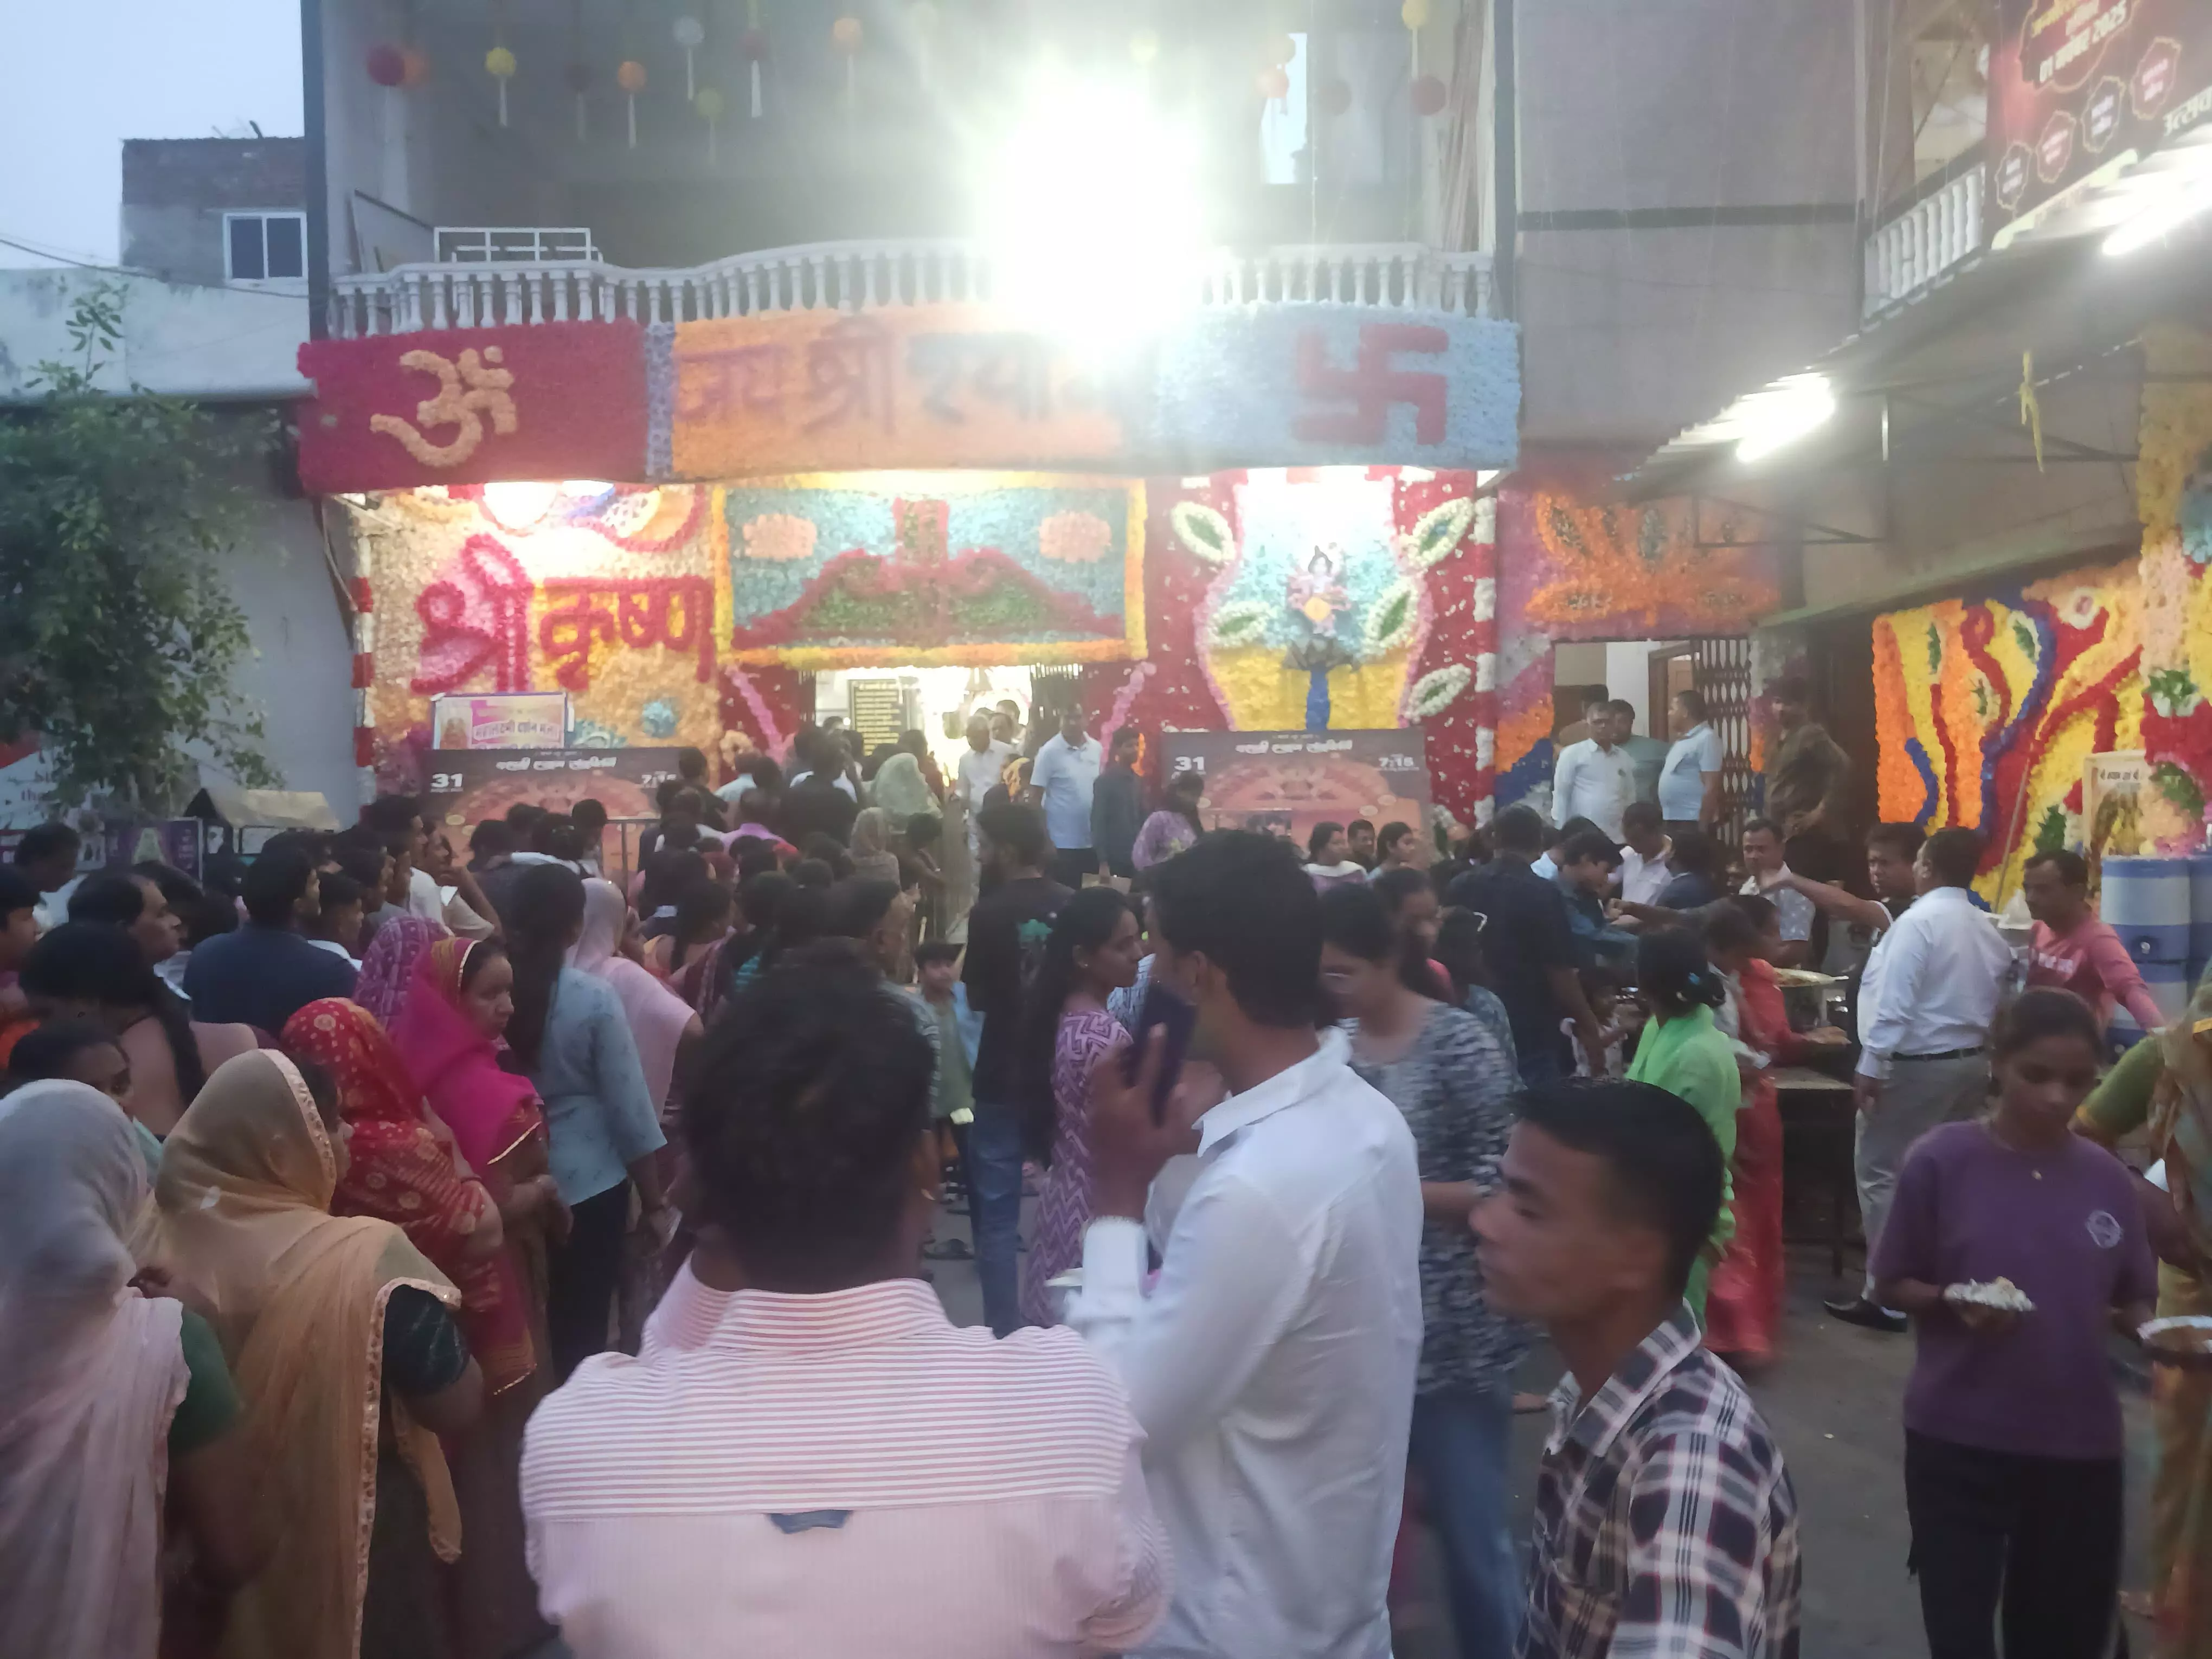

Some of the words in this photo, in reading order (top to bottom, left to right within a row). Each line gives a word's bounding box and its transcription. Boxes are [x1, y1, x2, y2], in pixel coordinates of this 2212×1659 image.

[410, 533, 535, 695] श्री
[1173, 756, 1205, 771] 31
[430, 773, 463, 788] 31
